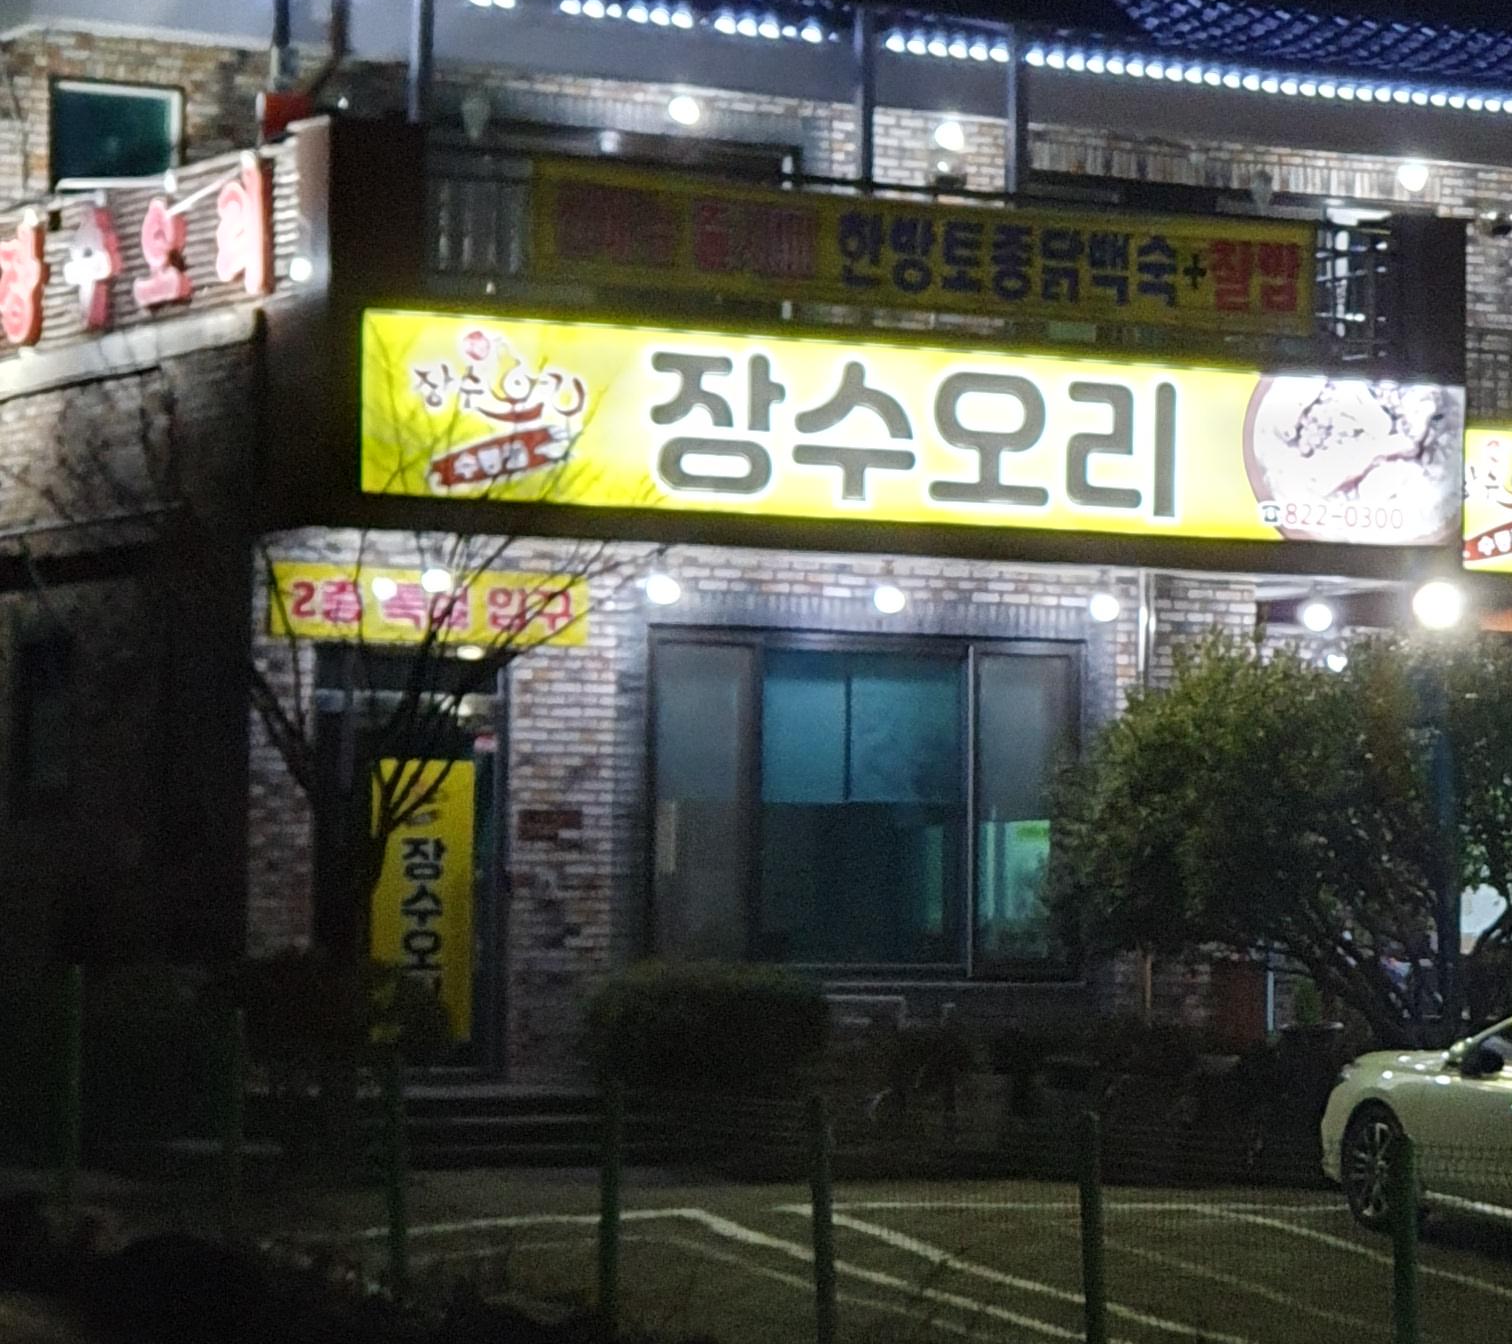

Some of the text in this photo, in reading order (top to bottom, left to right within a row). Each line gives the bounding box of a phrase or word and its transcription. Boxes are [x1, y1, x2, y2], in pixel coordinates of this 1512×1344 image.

[650, 351, 1177, 518] 장수오리
[1284, 502, 1405, 530] 822-0300
[487, 586, 574, 633] 입구
